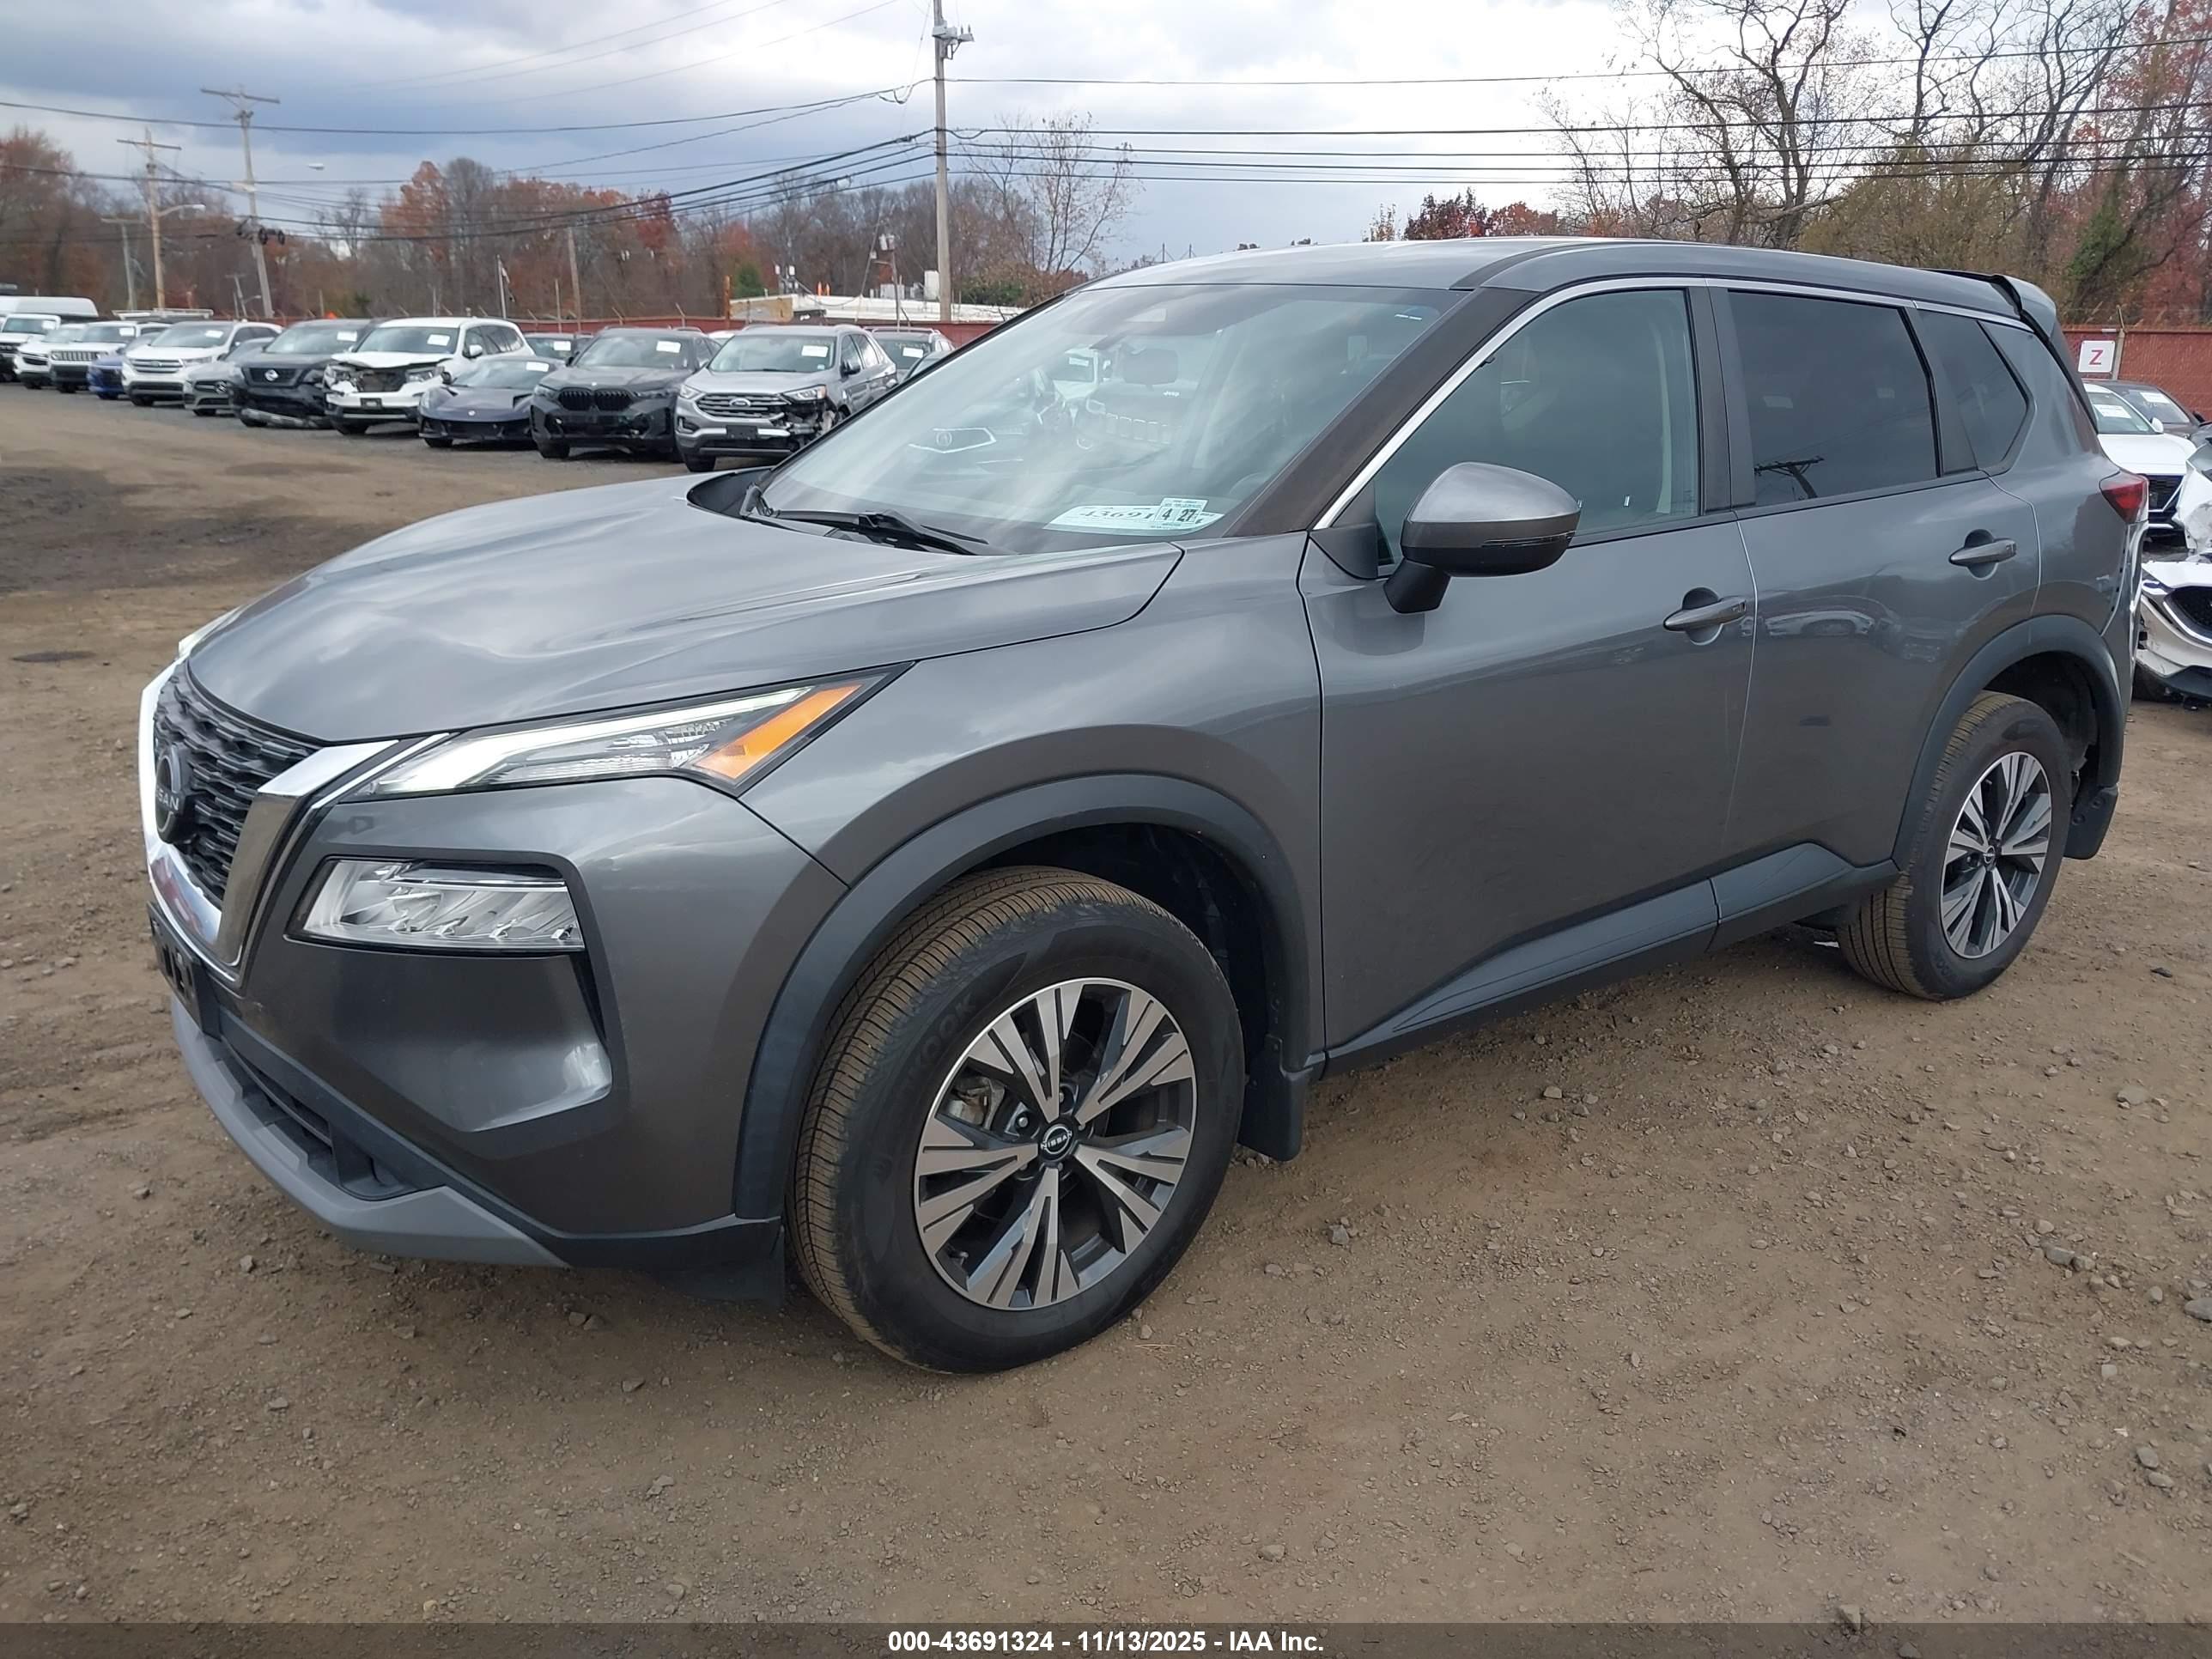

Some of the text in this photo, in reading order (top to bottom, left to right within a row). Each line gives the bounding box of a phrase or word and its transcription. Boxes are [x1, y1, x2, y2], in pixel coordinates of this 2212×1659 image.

[2088, 349, 2103, 365] Z
[1163, 508, 1196, 523] 4 27
[1040, 1129, 1073, 1150] NISSAN
